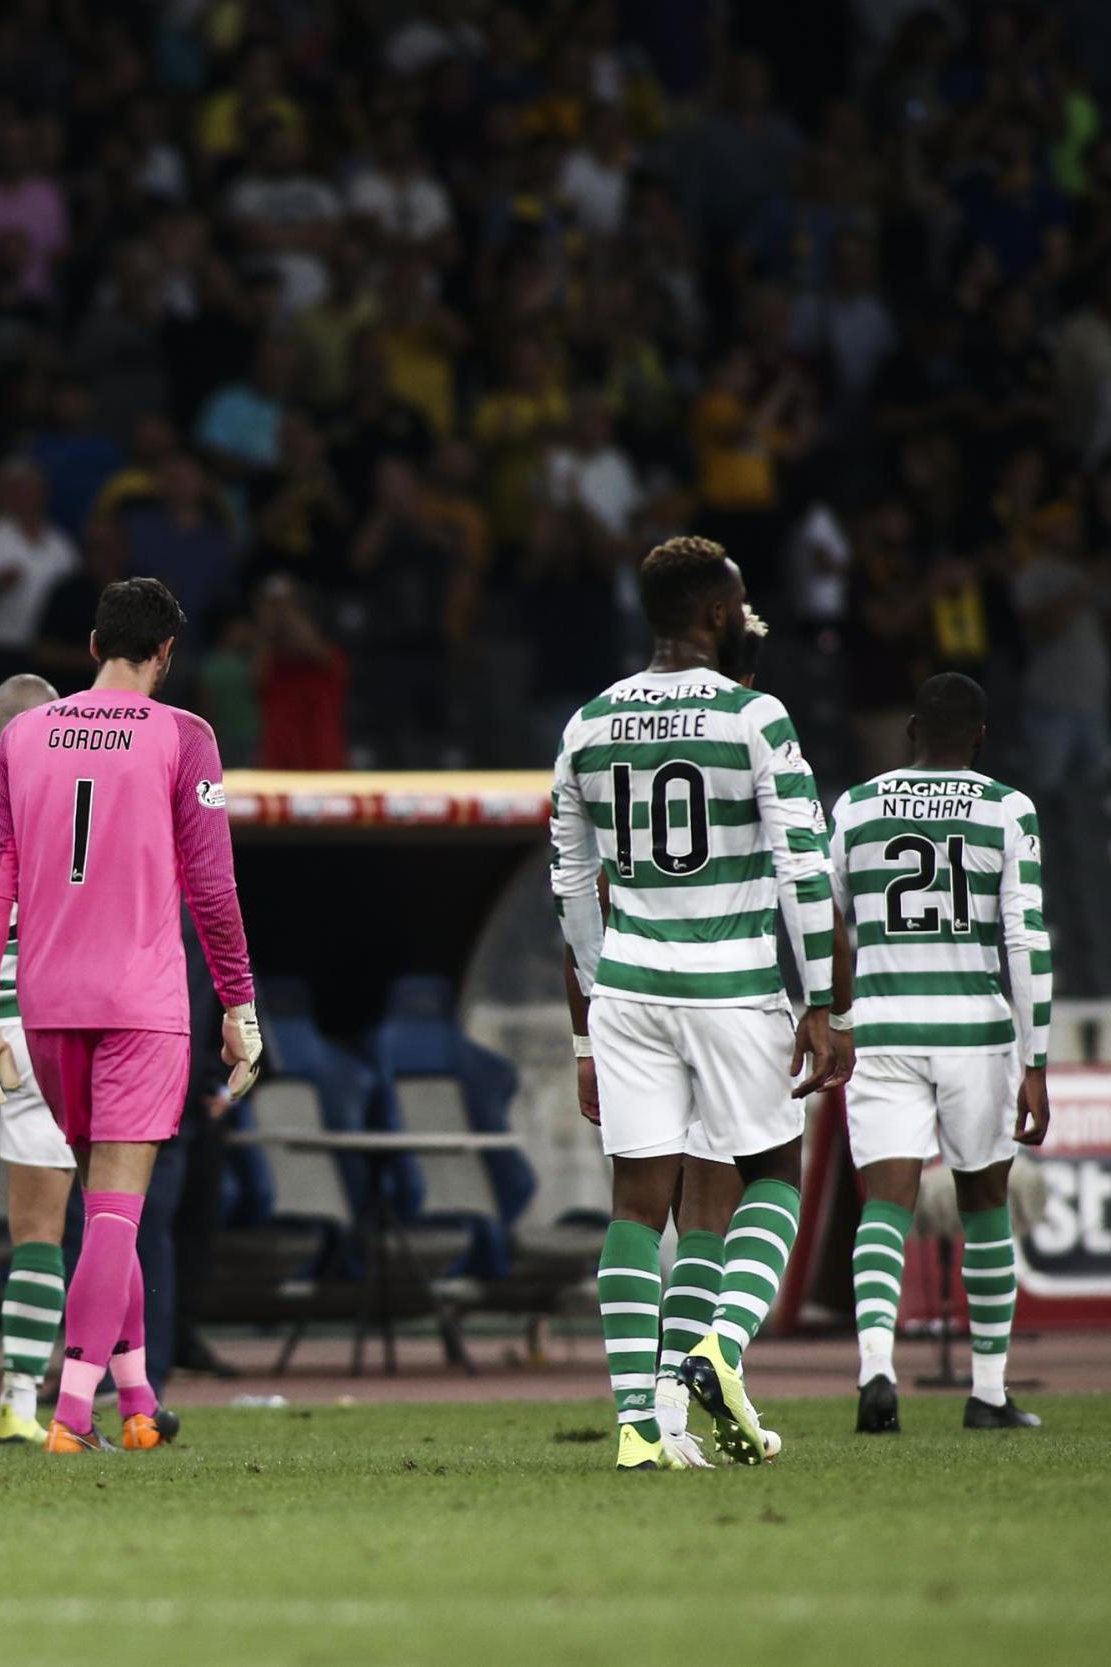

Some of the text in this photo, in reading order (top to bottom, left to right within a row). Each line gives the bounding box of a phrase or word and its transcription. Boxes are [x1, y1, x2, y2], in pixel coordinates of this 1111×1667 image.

[610, 685, 717, 704] MAGNERS
[46, 705, 151, 720] MAGNERS
[610, 708, 706, 741] DEMBÉLÉ
[48, 728, 132, 750] GORDON
[877, 779, 984, 798] MAGNERS
[611, 759, 710, 878] 10
[883, 798, 972, 819] NTCHAM
[69, 778, 94, 884] 1
[884, 833, 970, 935] 21
